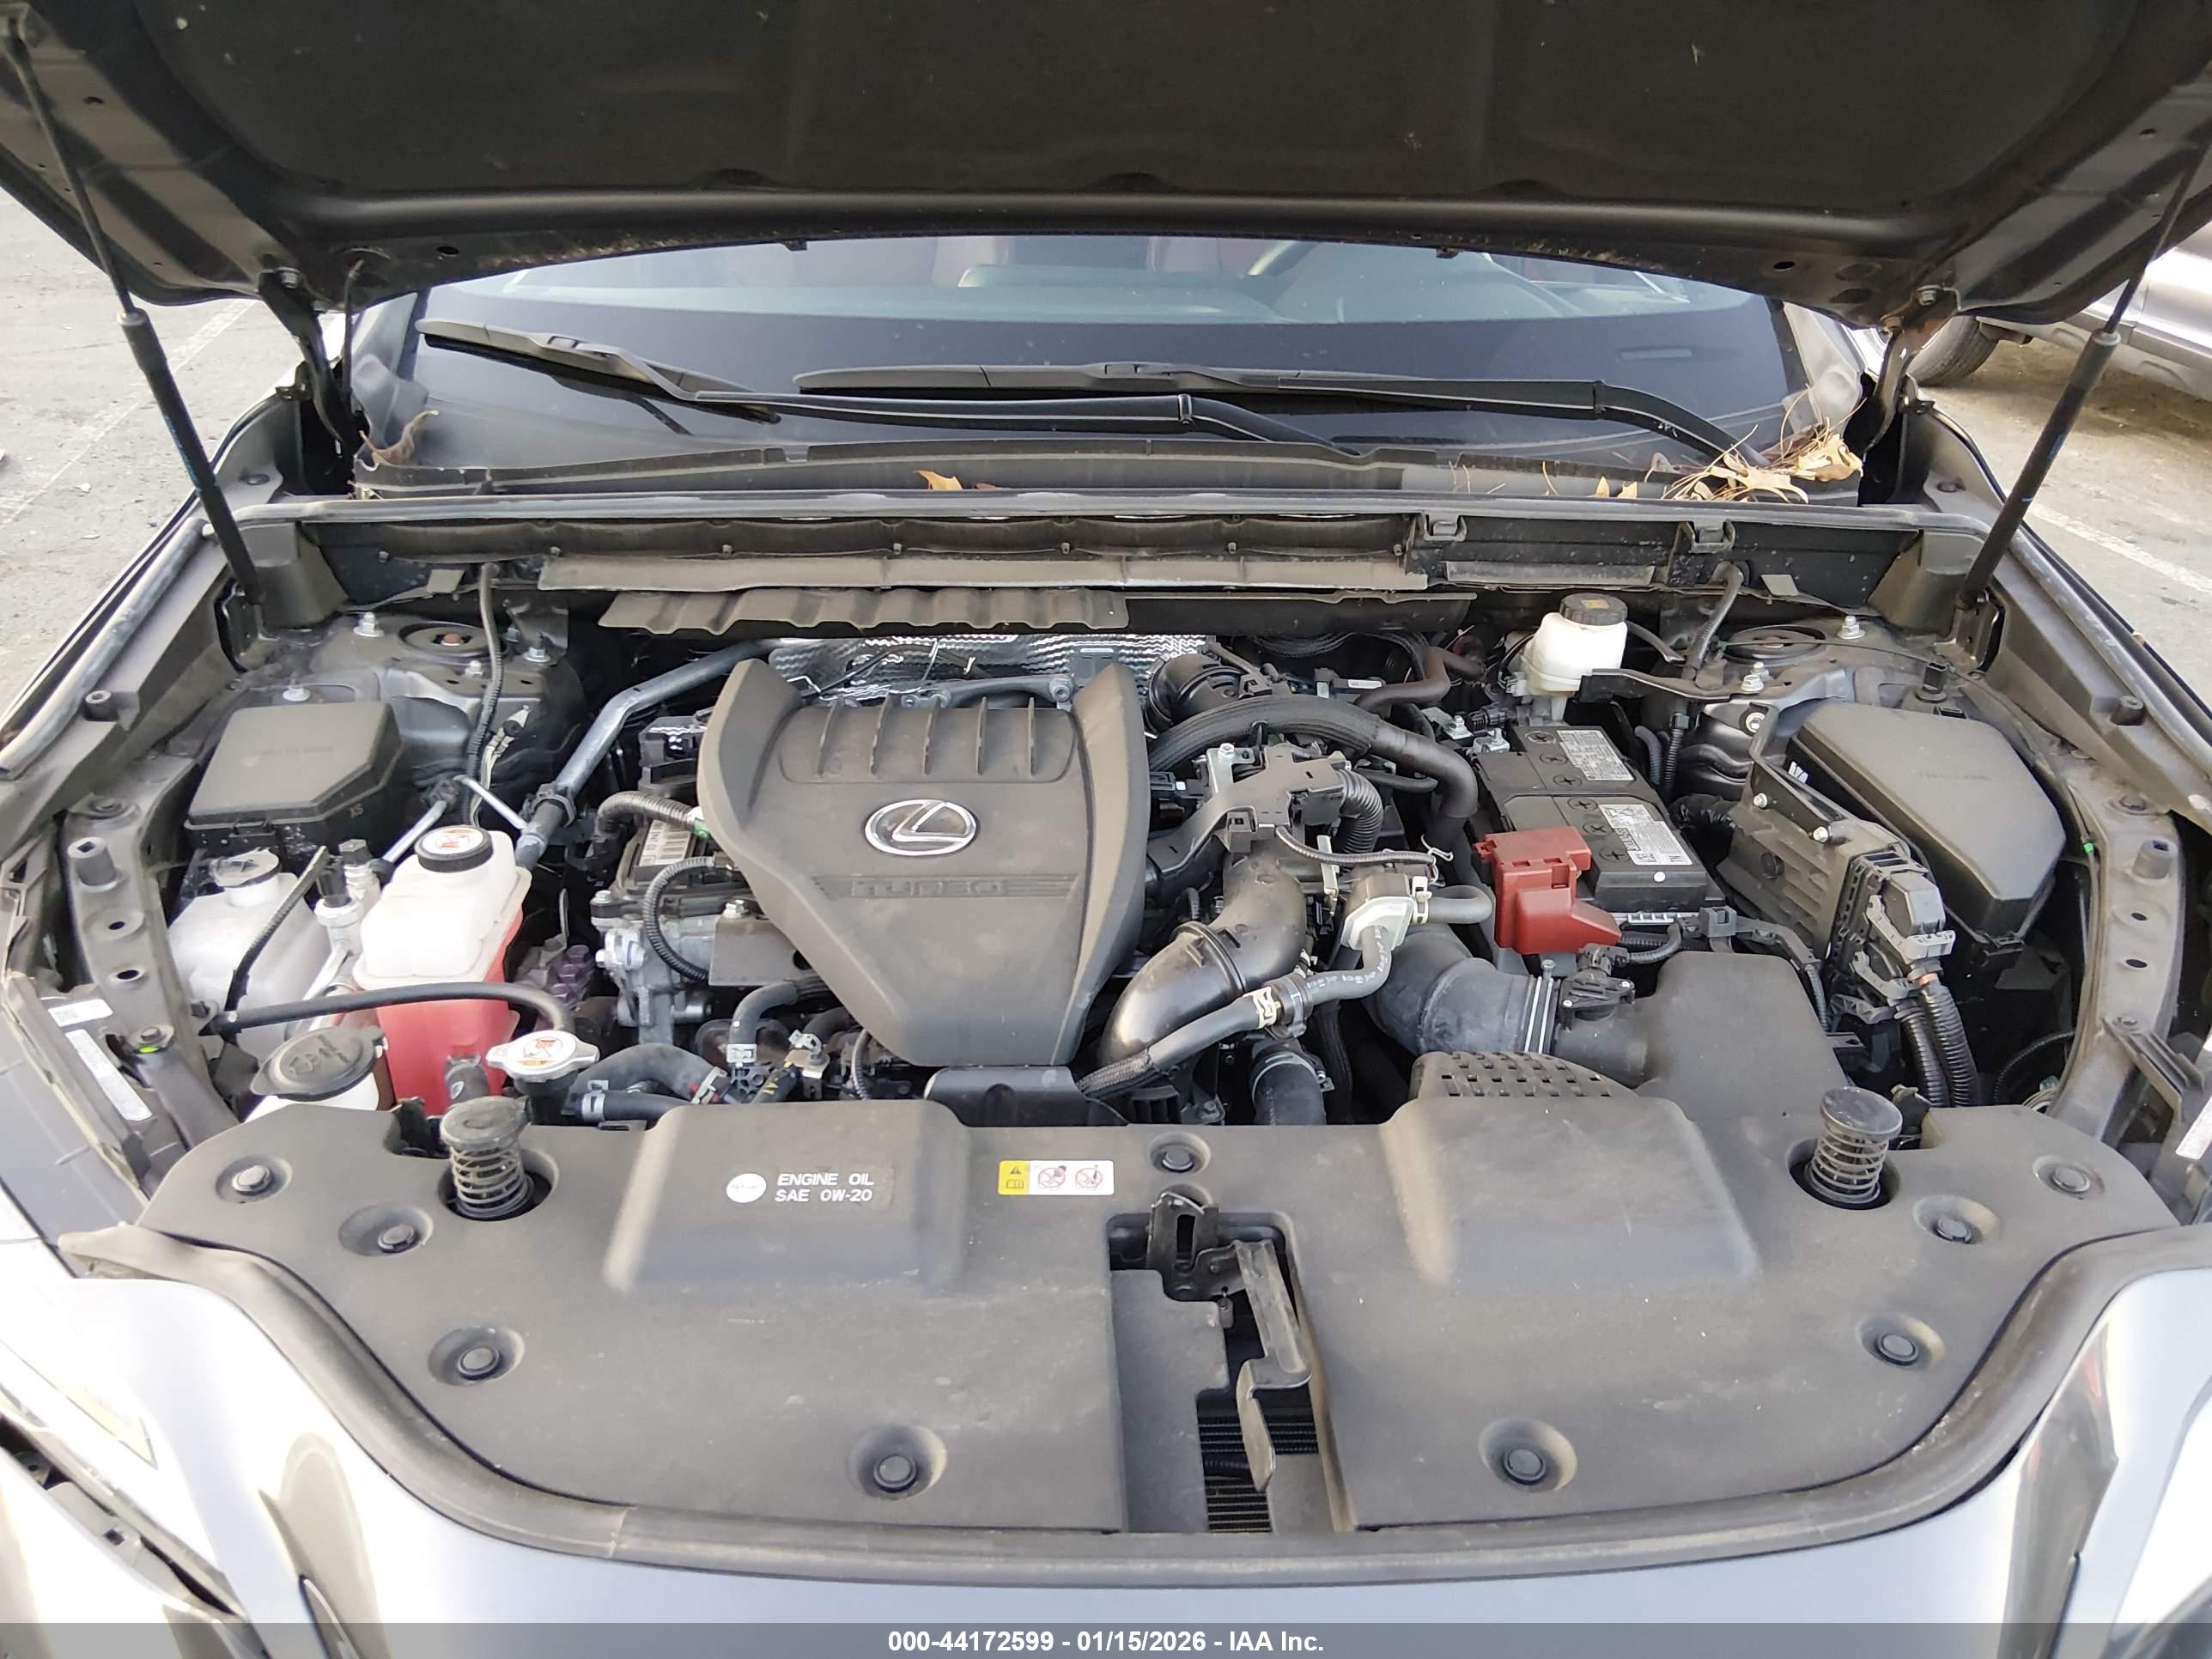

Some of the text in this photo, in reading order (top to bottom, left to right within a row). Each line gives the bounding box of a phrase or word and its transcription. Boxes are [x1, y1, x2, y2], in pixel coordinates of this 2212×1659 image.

[776, 1172, 875, 1187] ENGINE OIL
[774, 1188, 811, 1202] SAE
[819, 1188, 873, 1202] 0W-20
